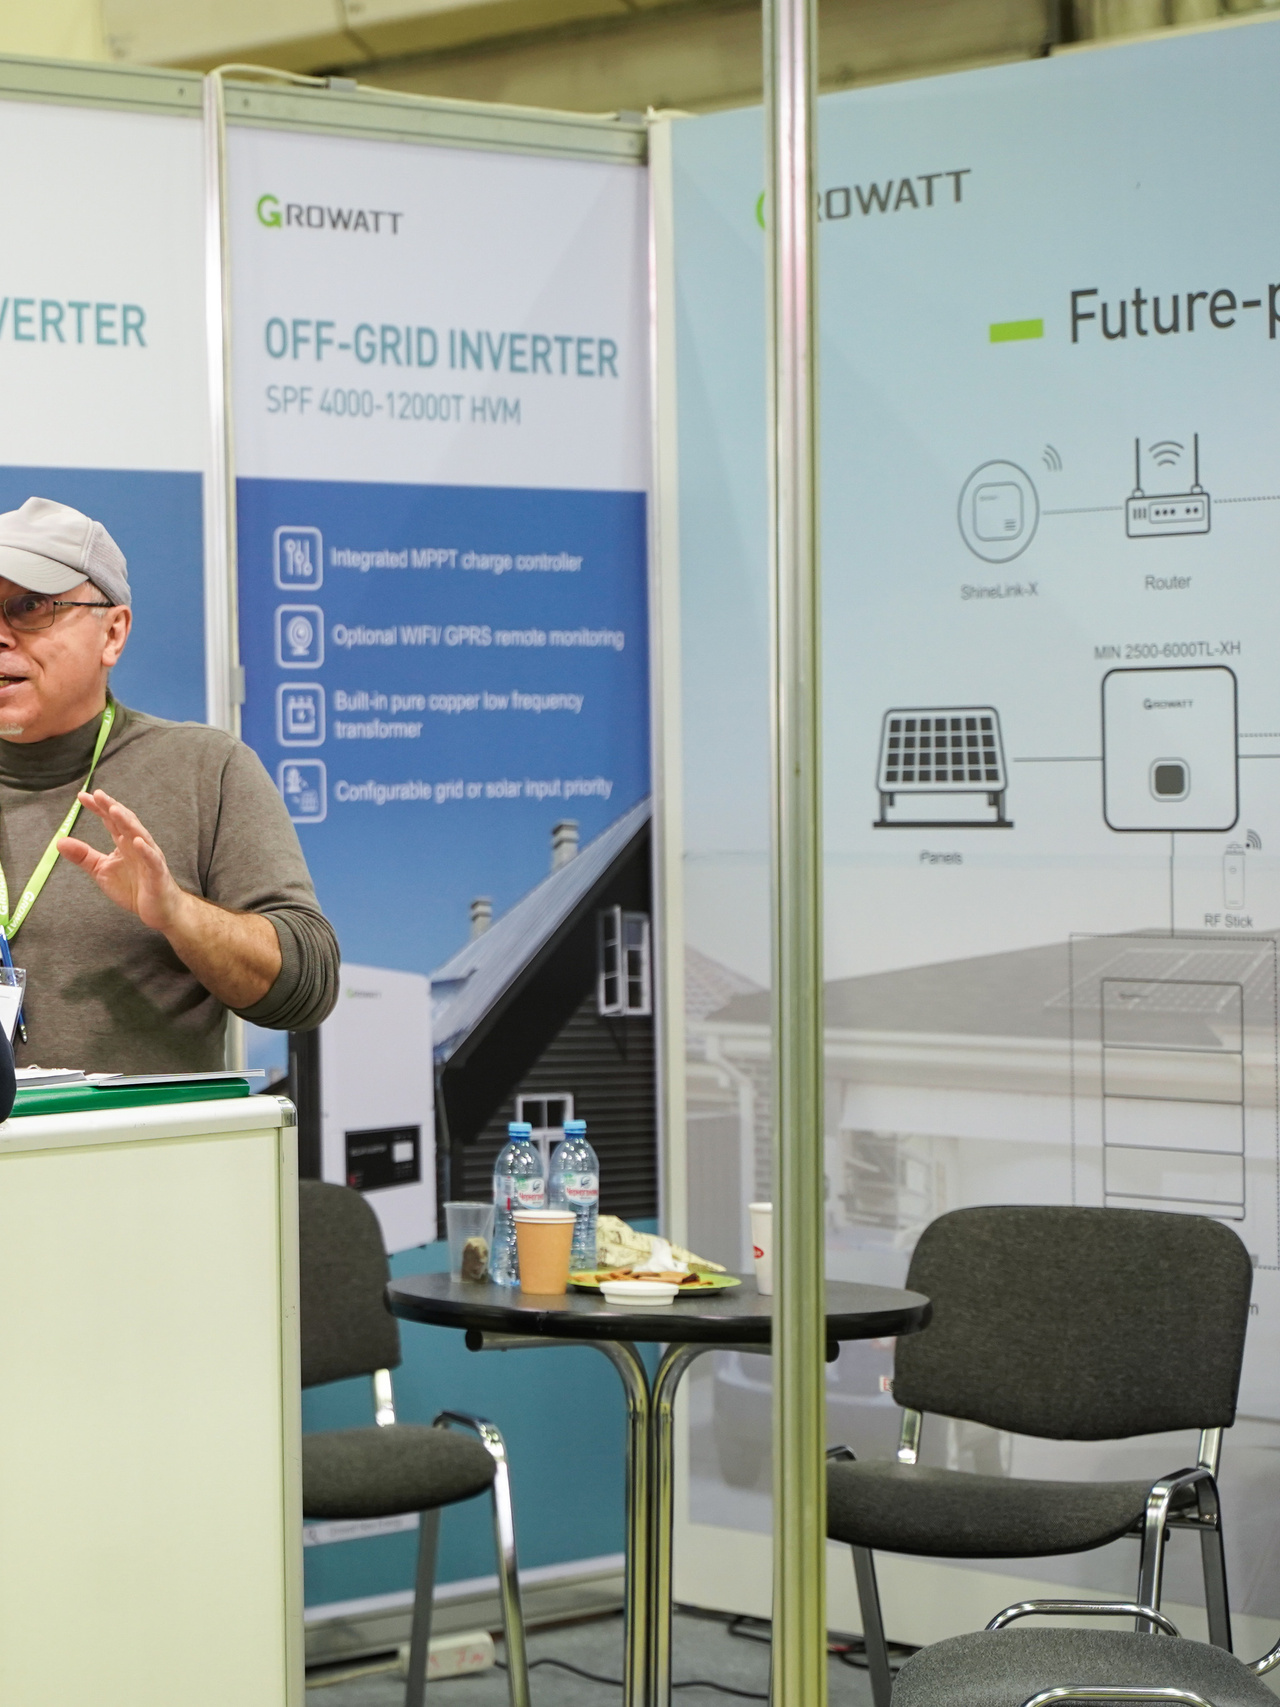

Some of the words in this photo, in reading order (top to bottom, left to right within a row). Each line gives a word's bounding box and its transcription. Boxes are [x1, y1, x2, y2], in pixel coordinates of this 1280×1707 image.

[257, 194, 404, 234] GROWATT
[264, 317, 439, 367] OFF-GRID
[449, 329, 619, 378] INVERTER
[266, 384, 313, 414] SPF
[319, 388, 465, 422] 4000-12000T
[470, 397, 520, 425] HVM
[331, 547, 408, 573] Integrated
[411, 548, 458, 569] MPPT
[460, 552, 513, 575] charge
[516, 552, 583, 572] controller
[960, 580, 1039, 601] ShineLink-X
[1144, 574, 1192, 591] Router
[332, 623, 397, 649] Optional
[444, 625, 492, 647] GPRS
[494, 629, 547, 647] remote
[549, 629, 625, 651] monitoring
[1094, 645, 1121, 660] MIN
[1125, 641, 1242, 659] 2500-6000TL-XH
[334, 690, 388, 712] Built-in
[390, 693, 426, 715] pure
[428, 693, 480, 714] copper
[482, 691, 509, 711] low
[511, 690, 585, 714] frequency
[334, 719, 424, 739] transformer
[333, 780, 432, 805] Configurable
[435, 780, 464, 804] grid
[466, 783, 482, 799] or
[484, 778, 522, 799] solar
[524, 779, 562, 800] input
[563, 775, 614, 800] priority
[920, 850, 963, 865] Panels
[1204, 913, 1221, 928] RF
[1224, 912, 1253, 929] Stick
